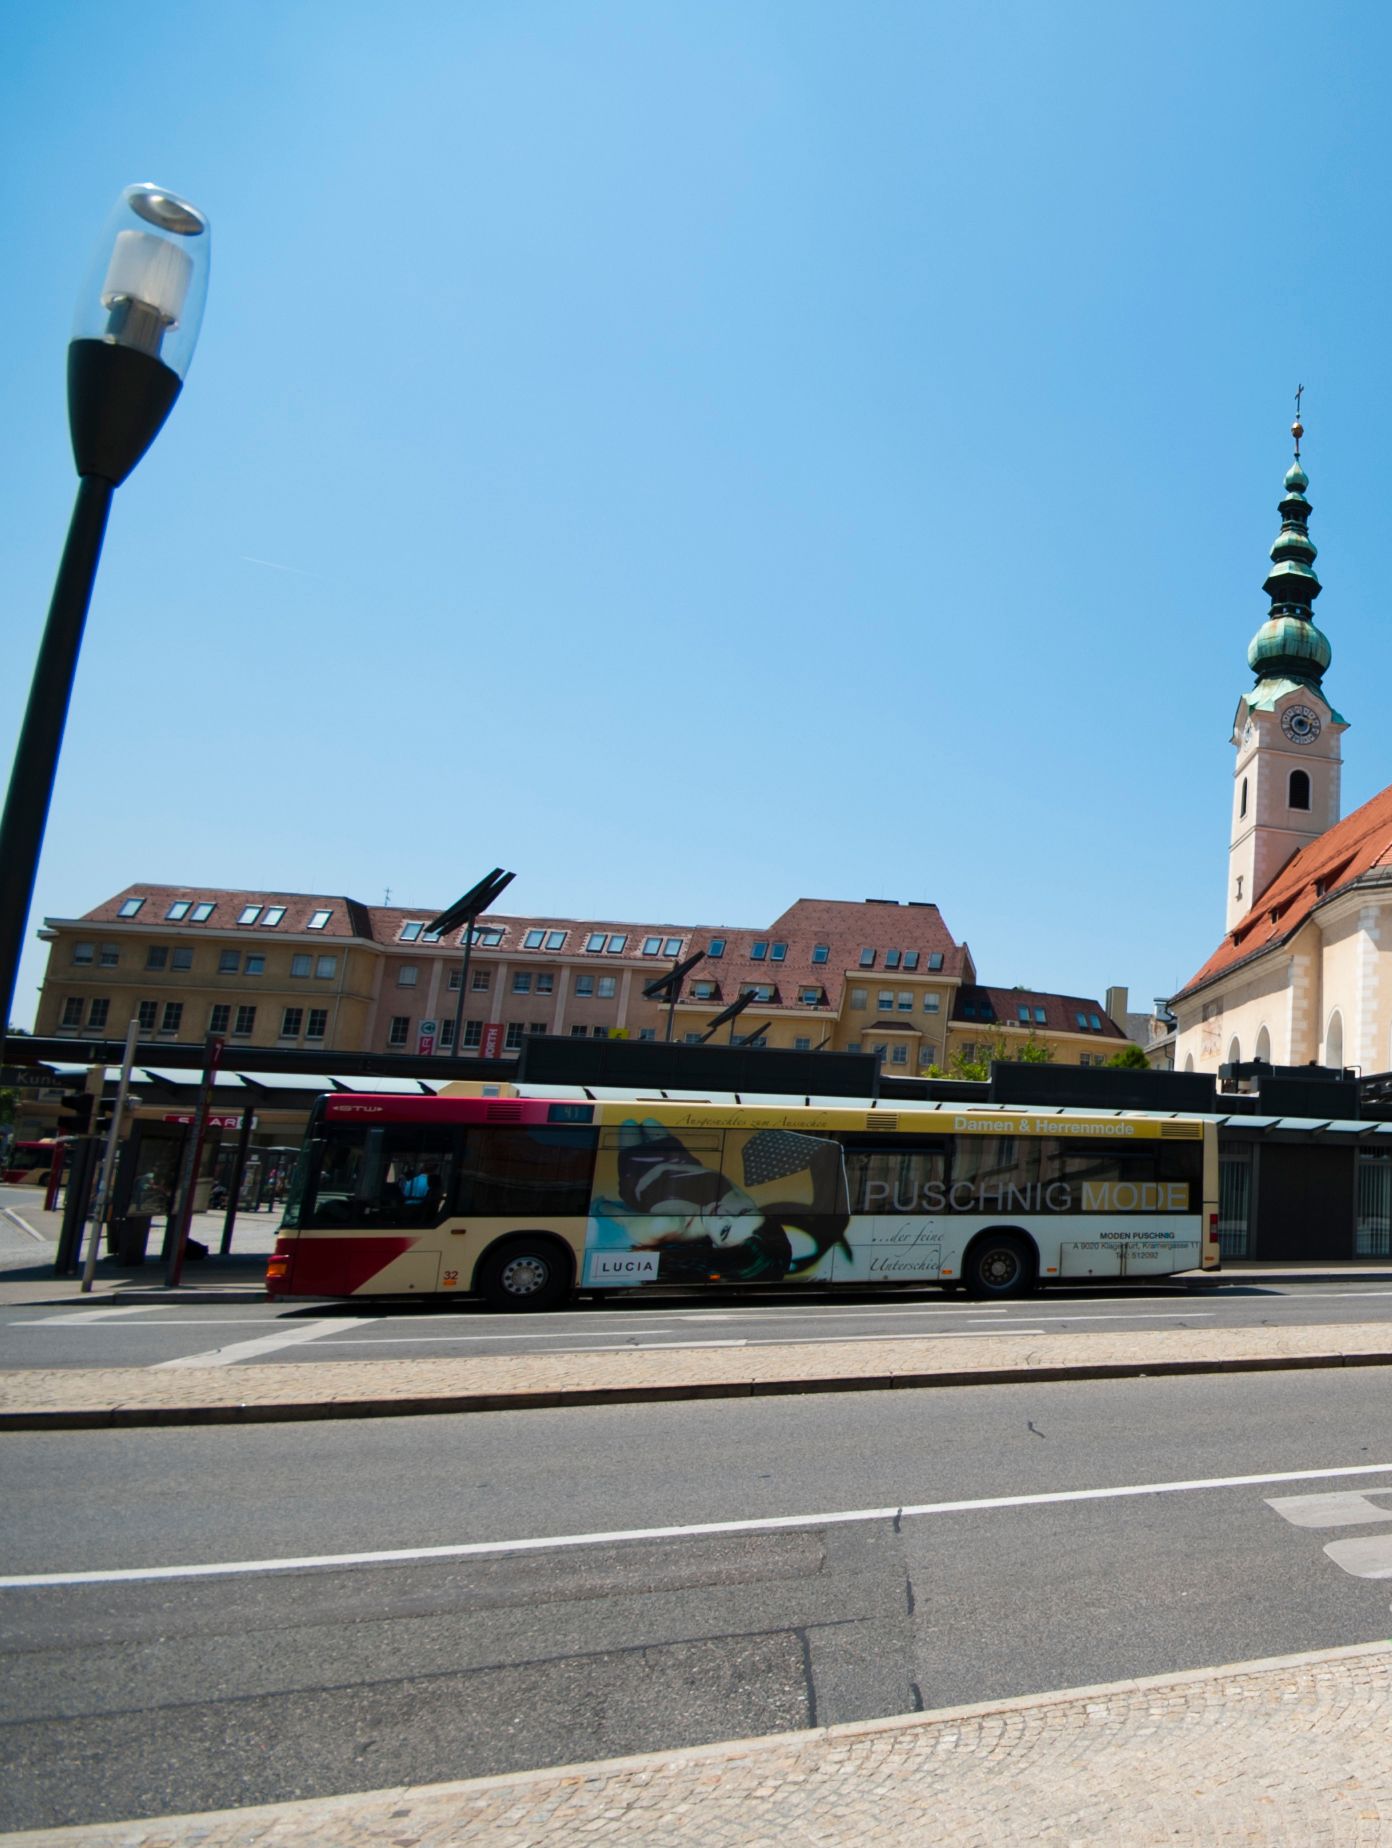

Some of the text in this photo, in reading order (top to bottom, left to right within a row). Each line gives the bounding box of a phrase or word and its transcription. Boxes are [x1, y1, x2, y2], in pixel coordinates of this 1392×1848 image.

[213, 1043, 222, 1063] 7
[177, 1117, 237, 1126] SAR
[954, 1117, 1135, 1135] Damen & Herrenmode
[864, 1181, 1189, 1212] PUSCHNIG MODE
[1100, 1232, 1175, 1240] MODEN PUSCHNIG
[602, 1261, 654, 1273] LUCIA
[870, 1248, 956, 1271] Unterschied
[443, 1271, 459, 1281] 32
